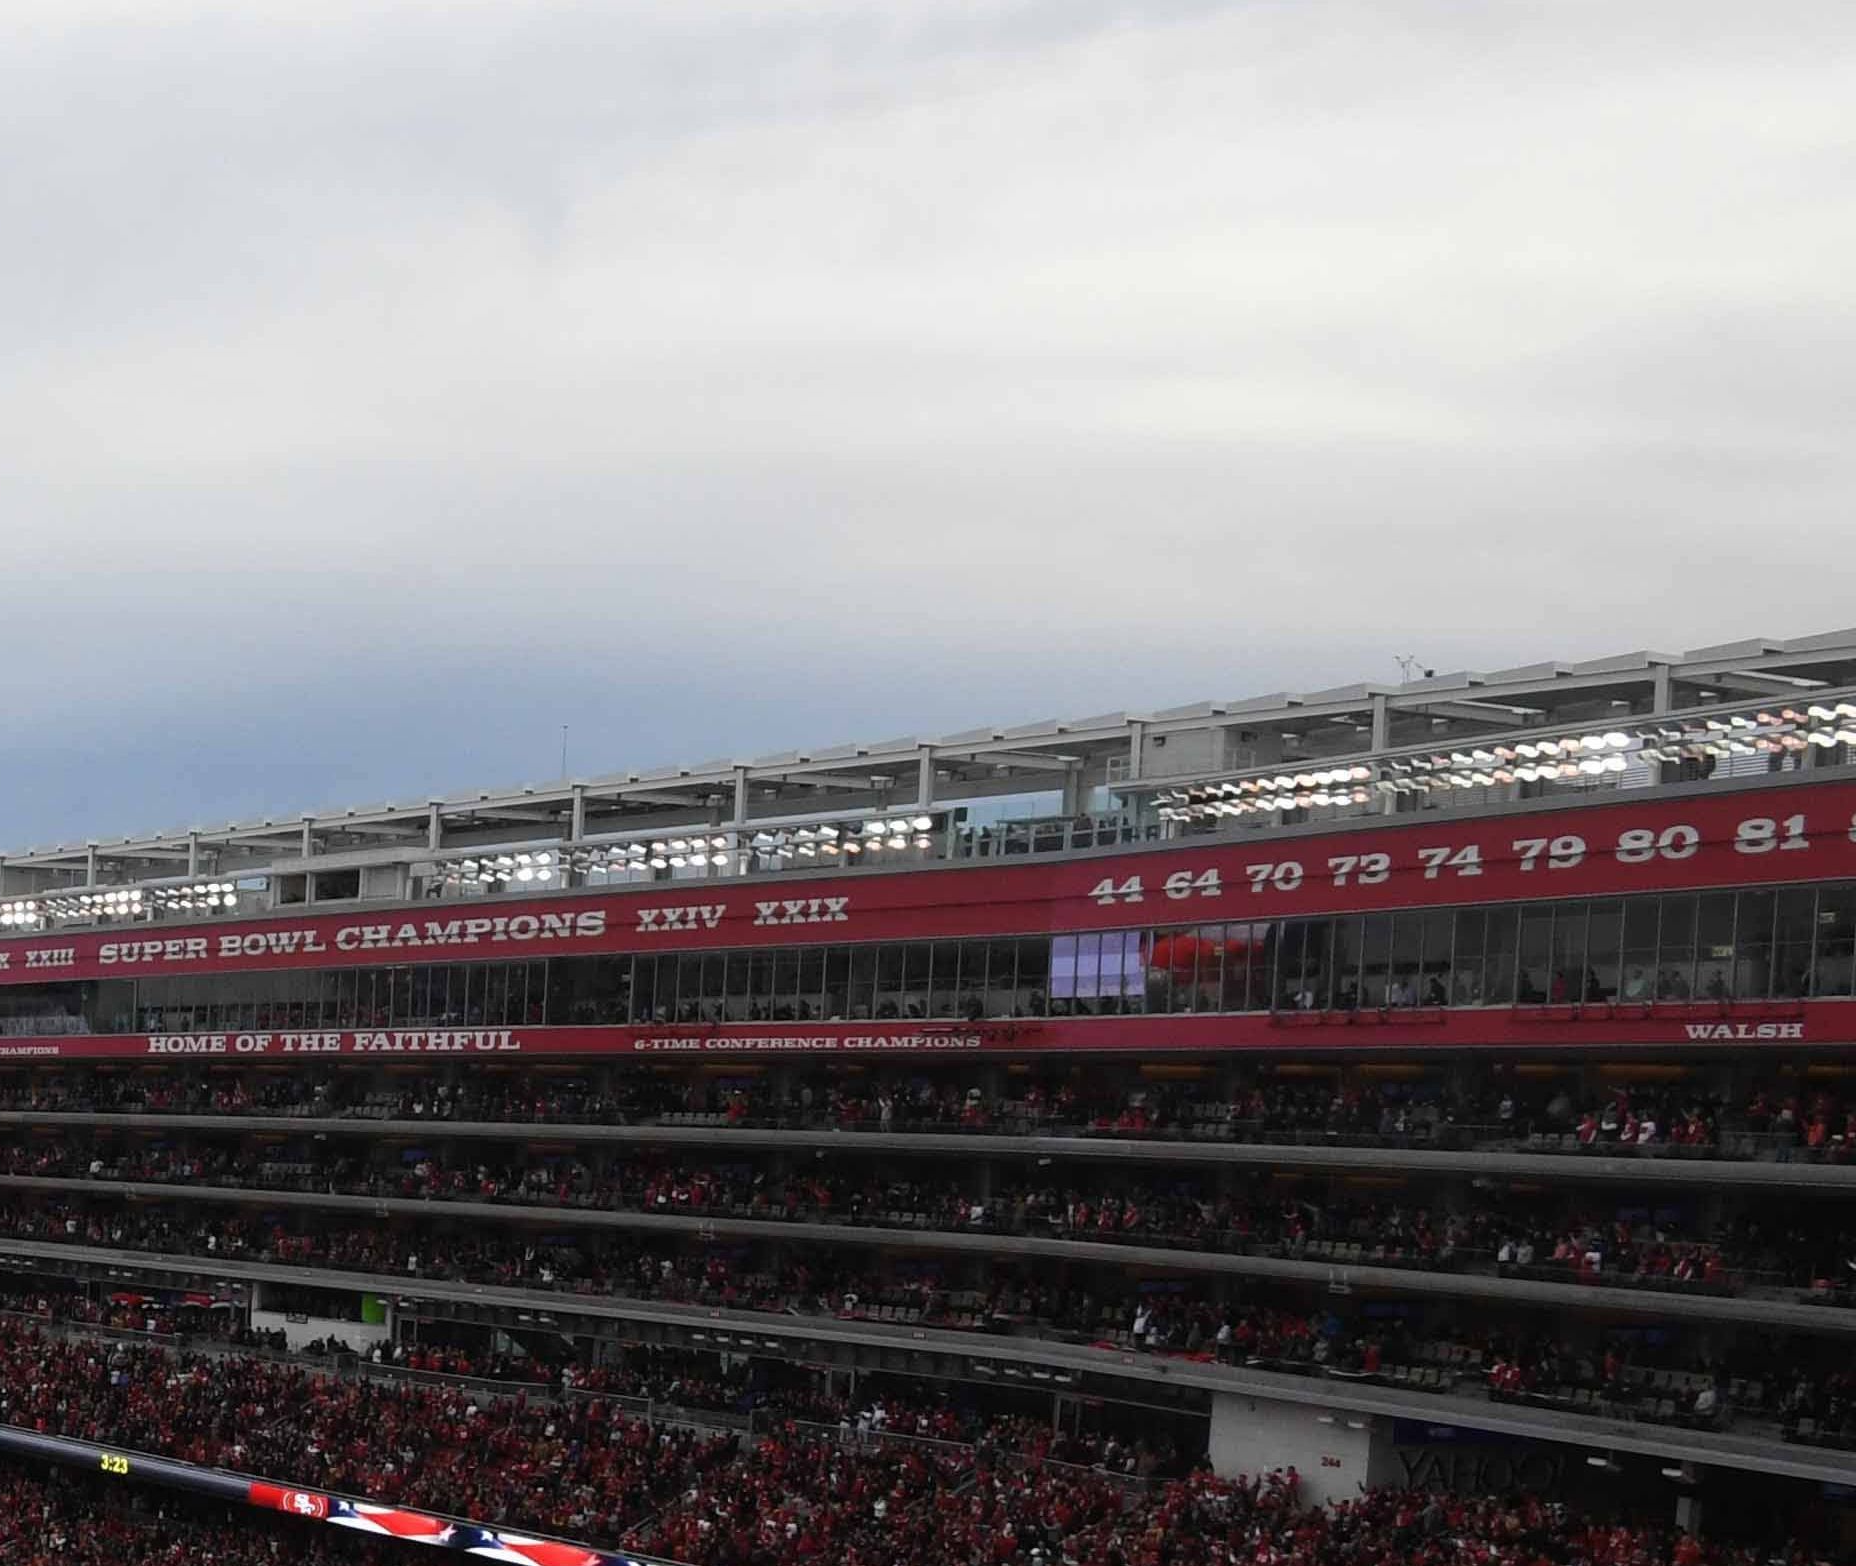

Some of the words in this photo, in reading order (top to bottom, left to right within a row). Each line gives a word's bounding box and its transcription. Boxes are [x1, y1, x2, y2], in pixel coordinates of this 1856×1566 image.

[1088, 877, 1145, 906] 44
[1164, 870, 1223, 900] 64
[1246, 861, 1305, 894] 70
[1327, 853, 1389, 887] 73
[1417, 845, 1484, 880] 74
[1511, 835, 1586, 870] 79
[1614, 824, 1700, 863] 80
[1734, 814, 1809, 853] 81
[98, 935, 208, 965] SUPER
[218, 929, 326, 957] BOWL
[337, 910, 607, 951] CHAMPIONS
[635, 903, 727, 933] XXIV
[753, 897, 850, 927] XXIX
[147, 1035, 228, 1055] HOME
[234, 1034, 274, 1054] OF
[280, 1032, 341, 1053] THE
[352, 1030, 520, 1052] FAITHFUL
[705, 1036, 837, 1050] CONFERENCE
[843, 1034, 981, 1049] CHAMPIONS
[1685, 1023, 1804, 1040] WALSH
[101, 1454, 129, 1475] 3:23
